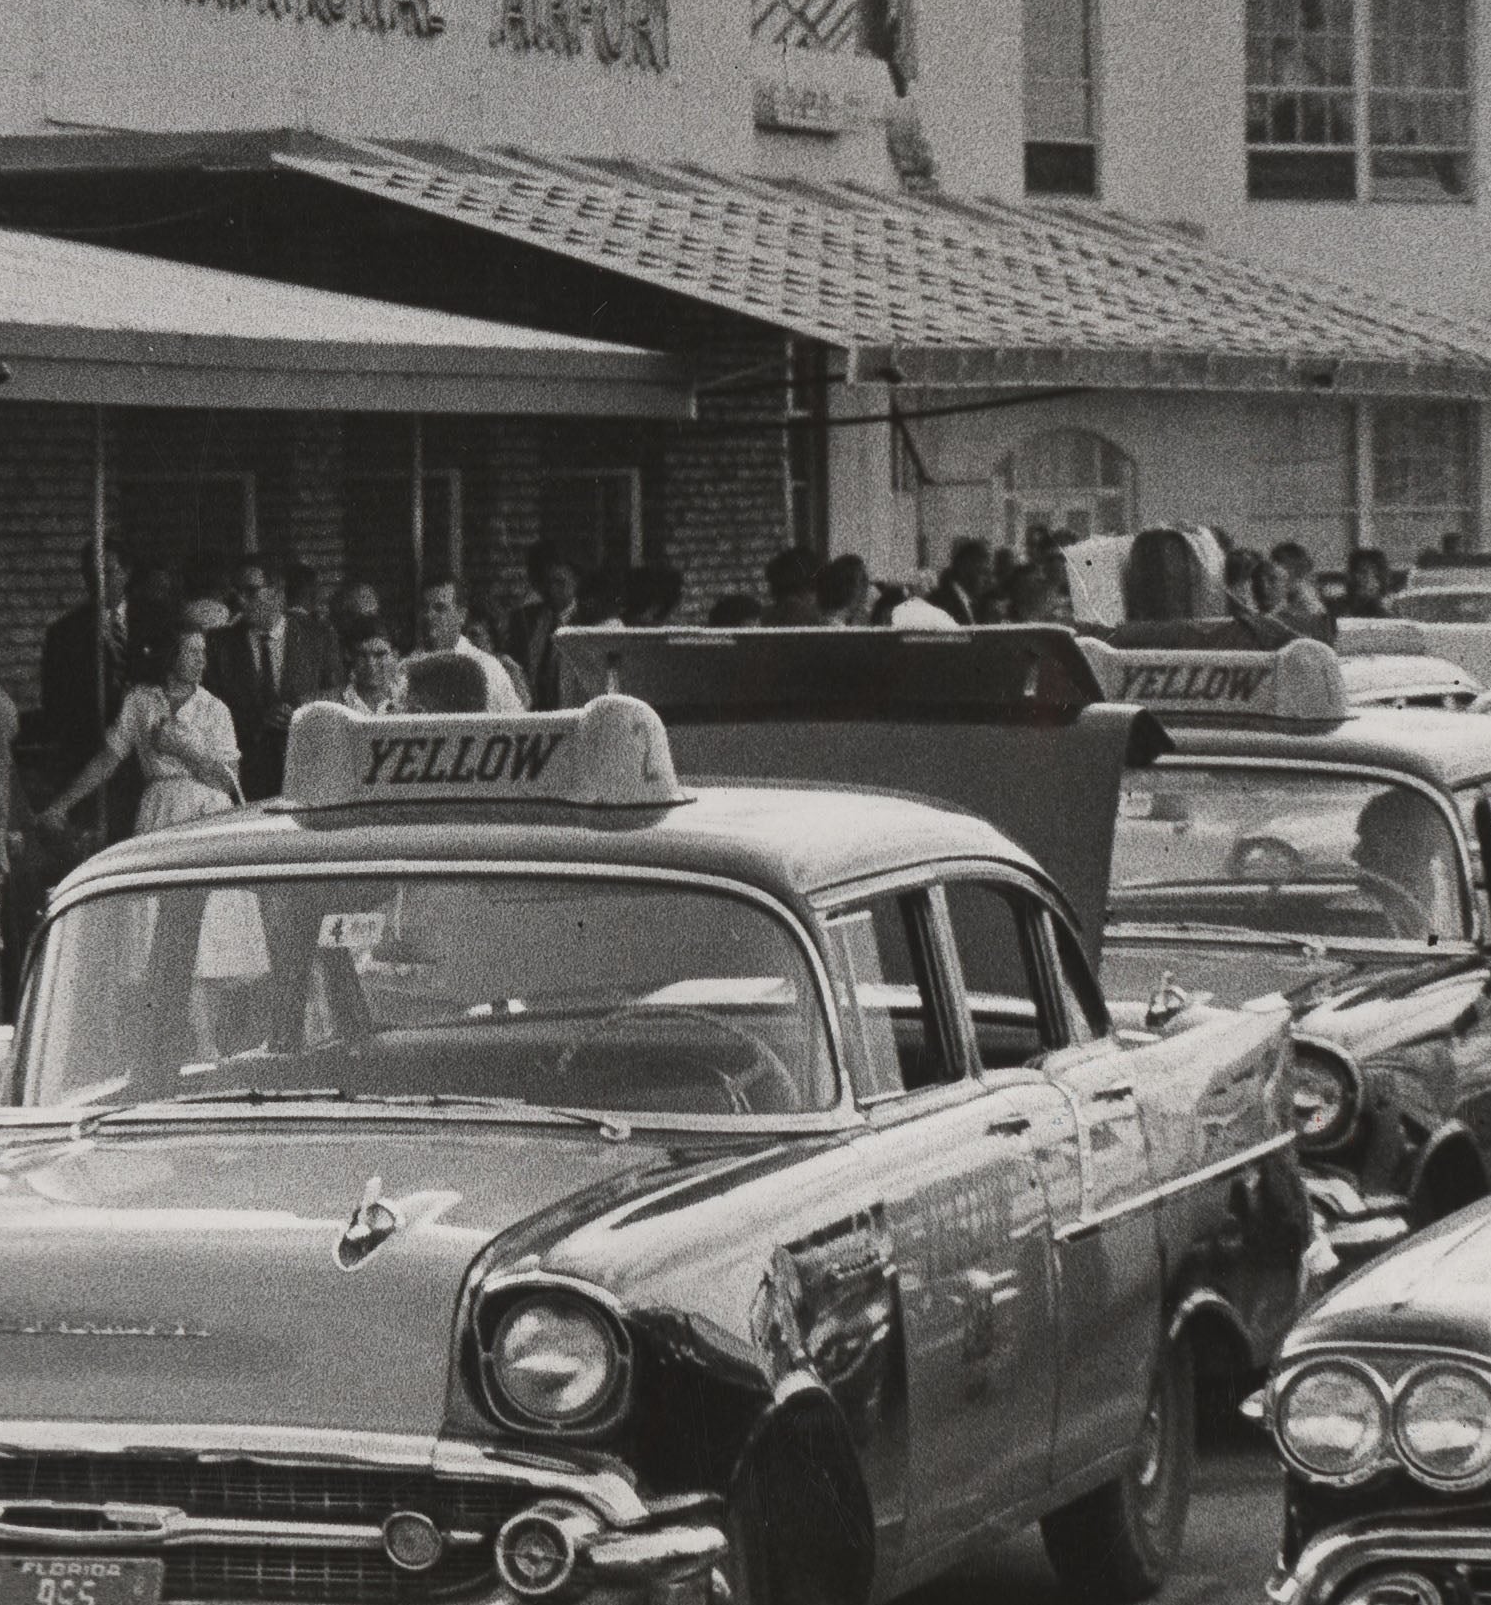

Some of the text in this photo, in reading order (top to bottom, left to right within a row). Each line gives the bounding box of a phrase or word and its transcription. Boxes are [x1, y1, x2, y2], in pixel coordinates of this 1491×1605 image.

[1116, 662, 1274, 704] YELLOW
[363, 732, 568, 785] YELLOW
[20, 1561, 122, 1578] FLORIDA
